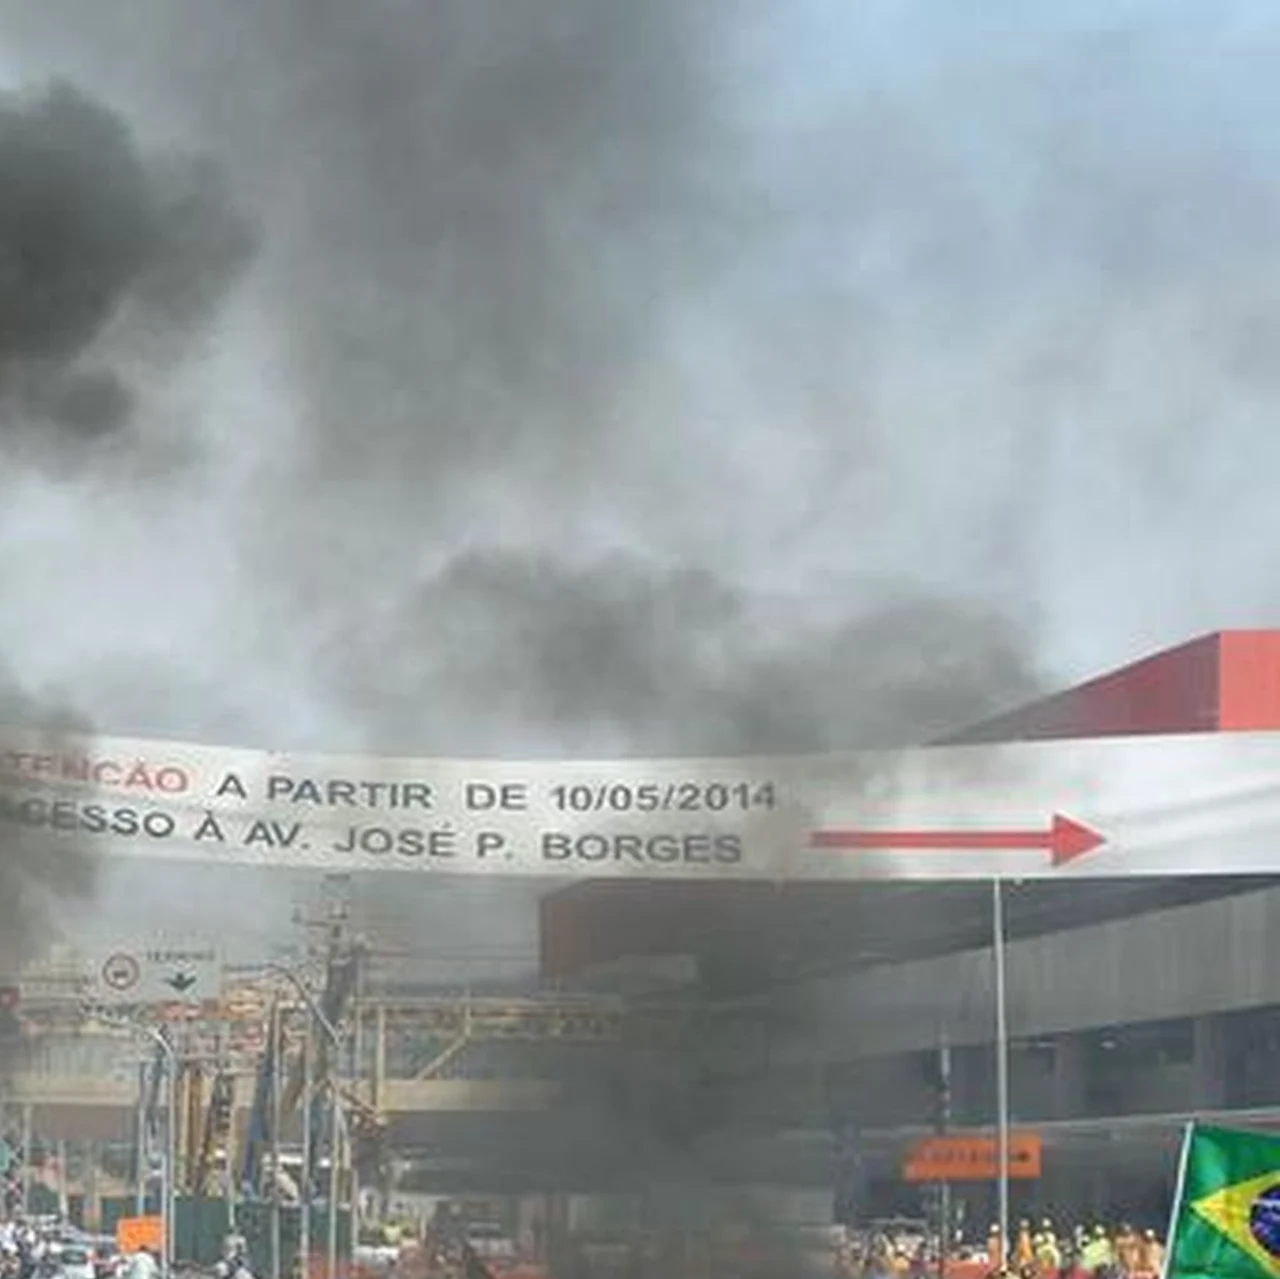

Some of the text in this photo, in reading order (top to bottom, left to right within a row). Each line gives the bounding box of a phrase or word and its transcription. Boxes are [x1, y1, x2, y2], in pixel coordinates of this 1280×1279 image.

[216, 772, 247, 798] A
[268, 776, 432, 808] PARTIR
[466, 784, 528, 811] DE
[551, 782, 775, 812] 10/05/2014
[243, 820, 311, 850] AV.
[333, 820, 457, 857] JOSÉ
[477, 832, 514, 860] P.
[542, 832, 742, 863] BORGES
